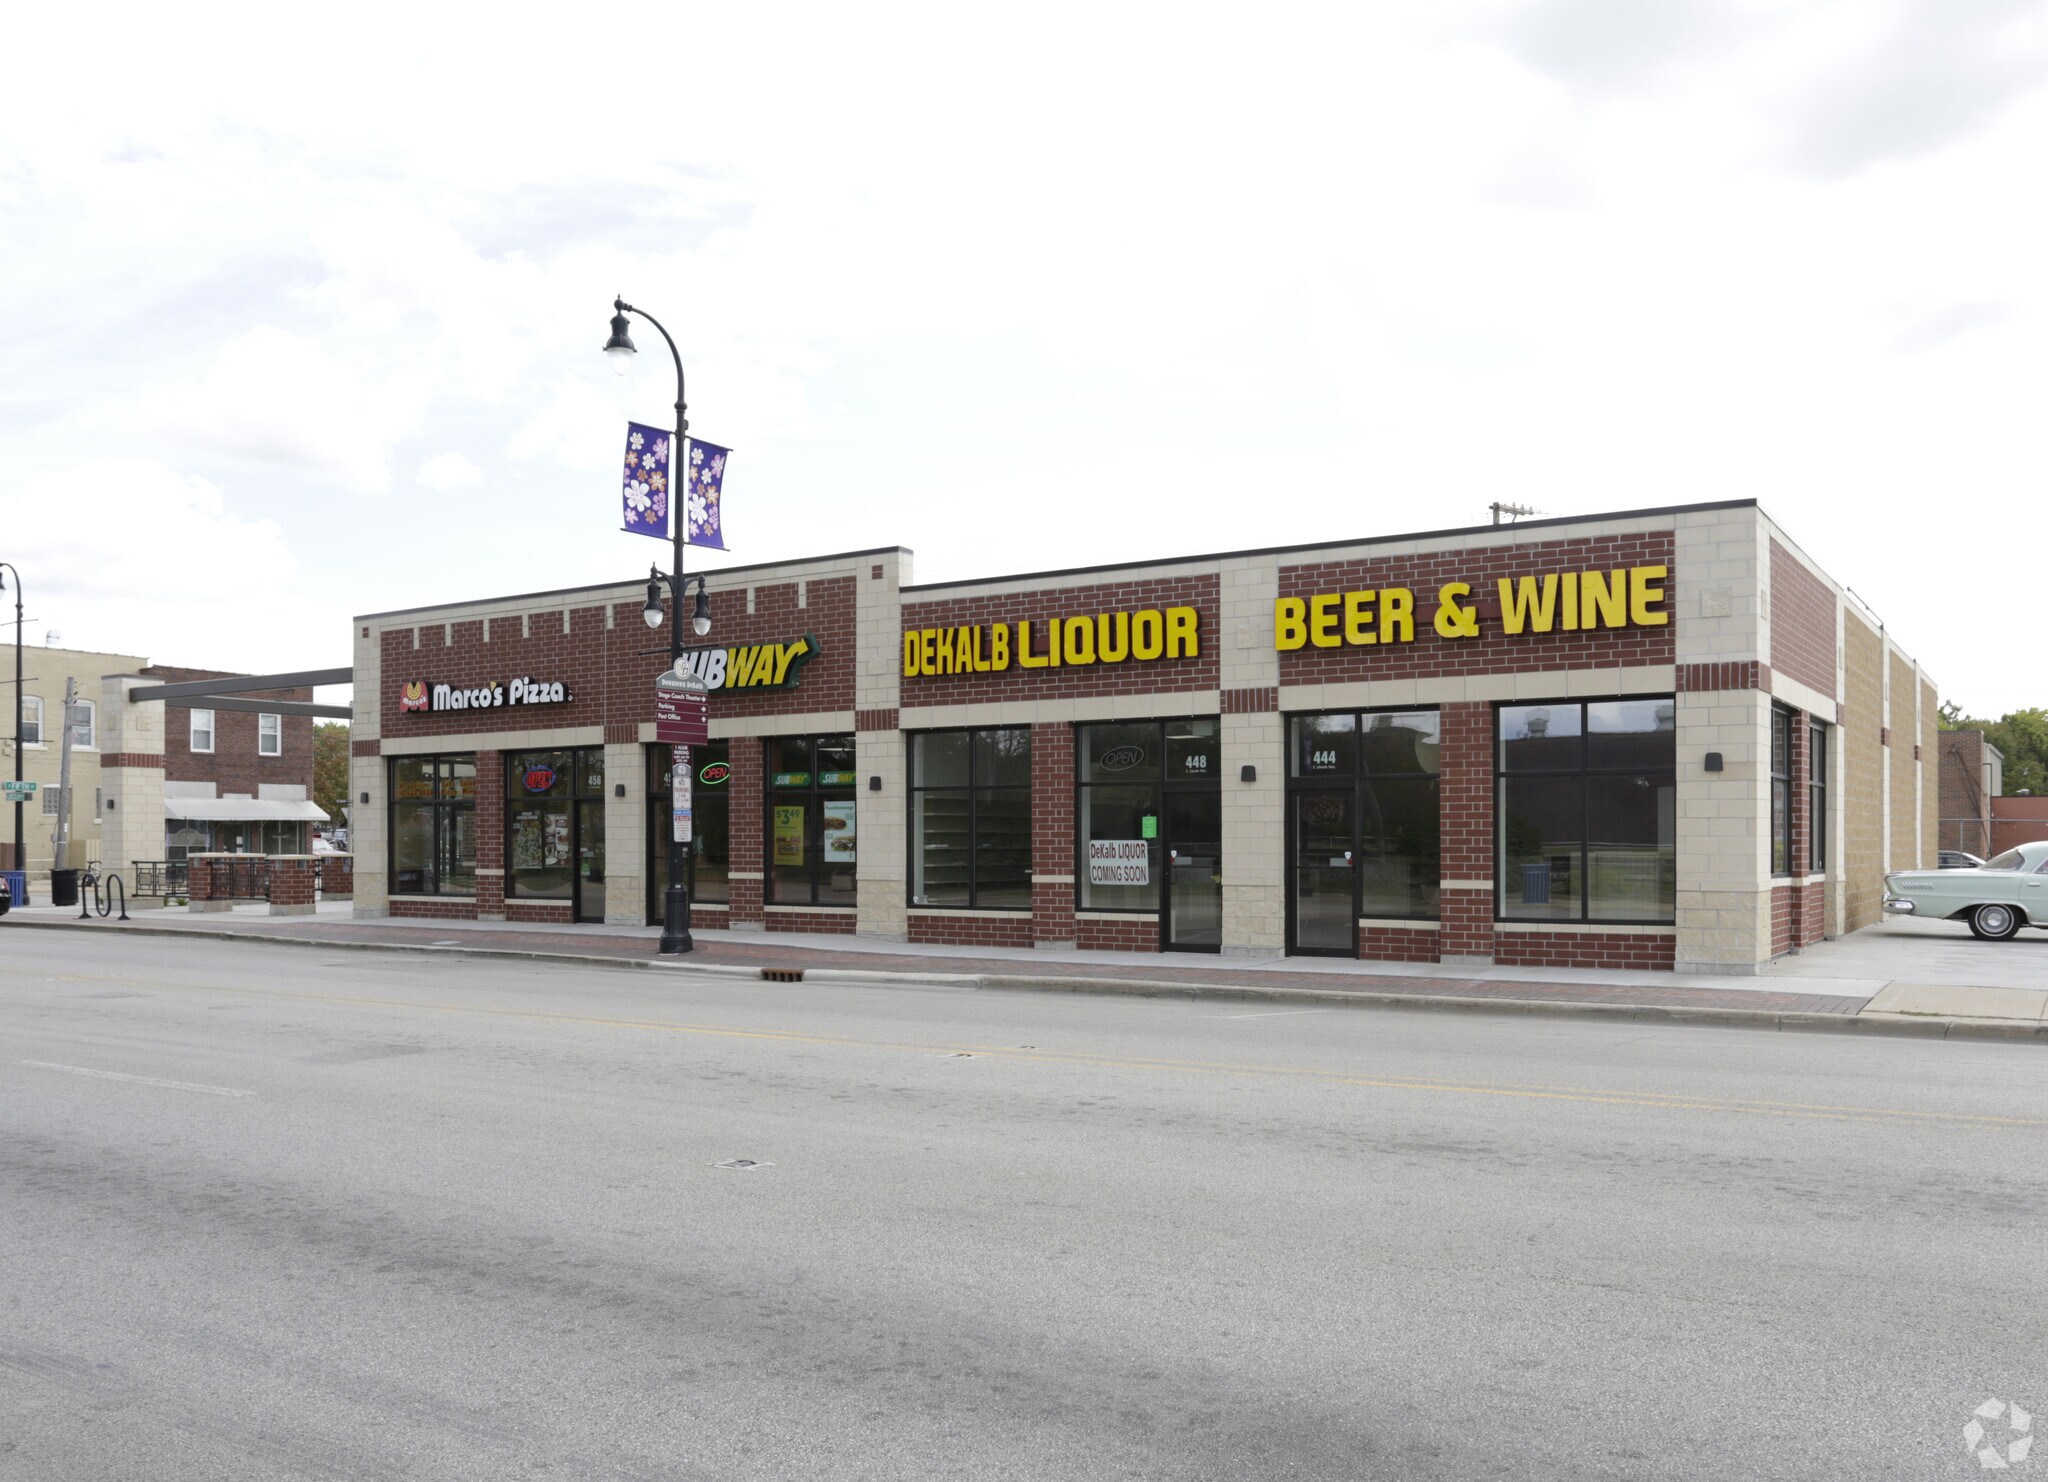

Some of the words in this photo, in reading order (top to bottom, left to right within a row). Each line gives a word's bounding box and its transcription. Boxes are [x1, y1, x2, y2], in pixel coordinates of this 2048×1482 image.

[1276, 588, 1413, 651] BEER
[1434, 582, 1479, 637] &
[1500, 567, 1667, 633] WINE
[903, 622, 1010, 677] DEKALB
[1019, 606, 1198, 668] LIQUOR
[683, 638, 808, 690] UBWAY
[433, 682, 503, 711] Marco's
[509, 676, 564, 705] Pizza
[658, 702, 675, 711] Parking
[1105, 751, 1138, 765] OPEN
[1185, 755, 1207, 768] 448
[1313, 751, 1336, 764] 444
[526, 771, 552, 788] OPEN
[703, 767, 728, 779] OPEN
[775, 774, 807, 785] SUBWAY
[823, 773, 856, 784] SUBWAY
[588, 775, 602, 786] 456
[1090, 842, 1117, 859] DeKalb
[1118, 843, 1146, 861] LIQUOR
[1091, 866, 1122, 881] COMING
[1123, 866, 1147, 882] SOON
